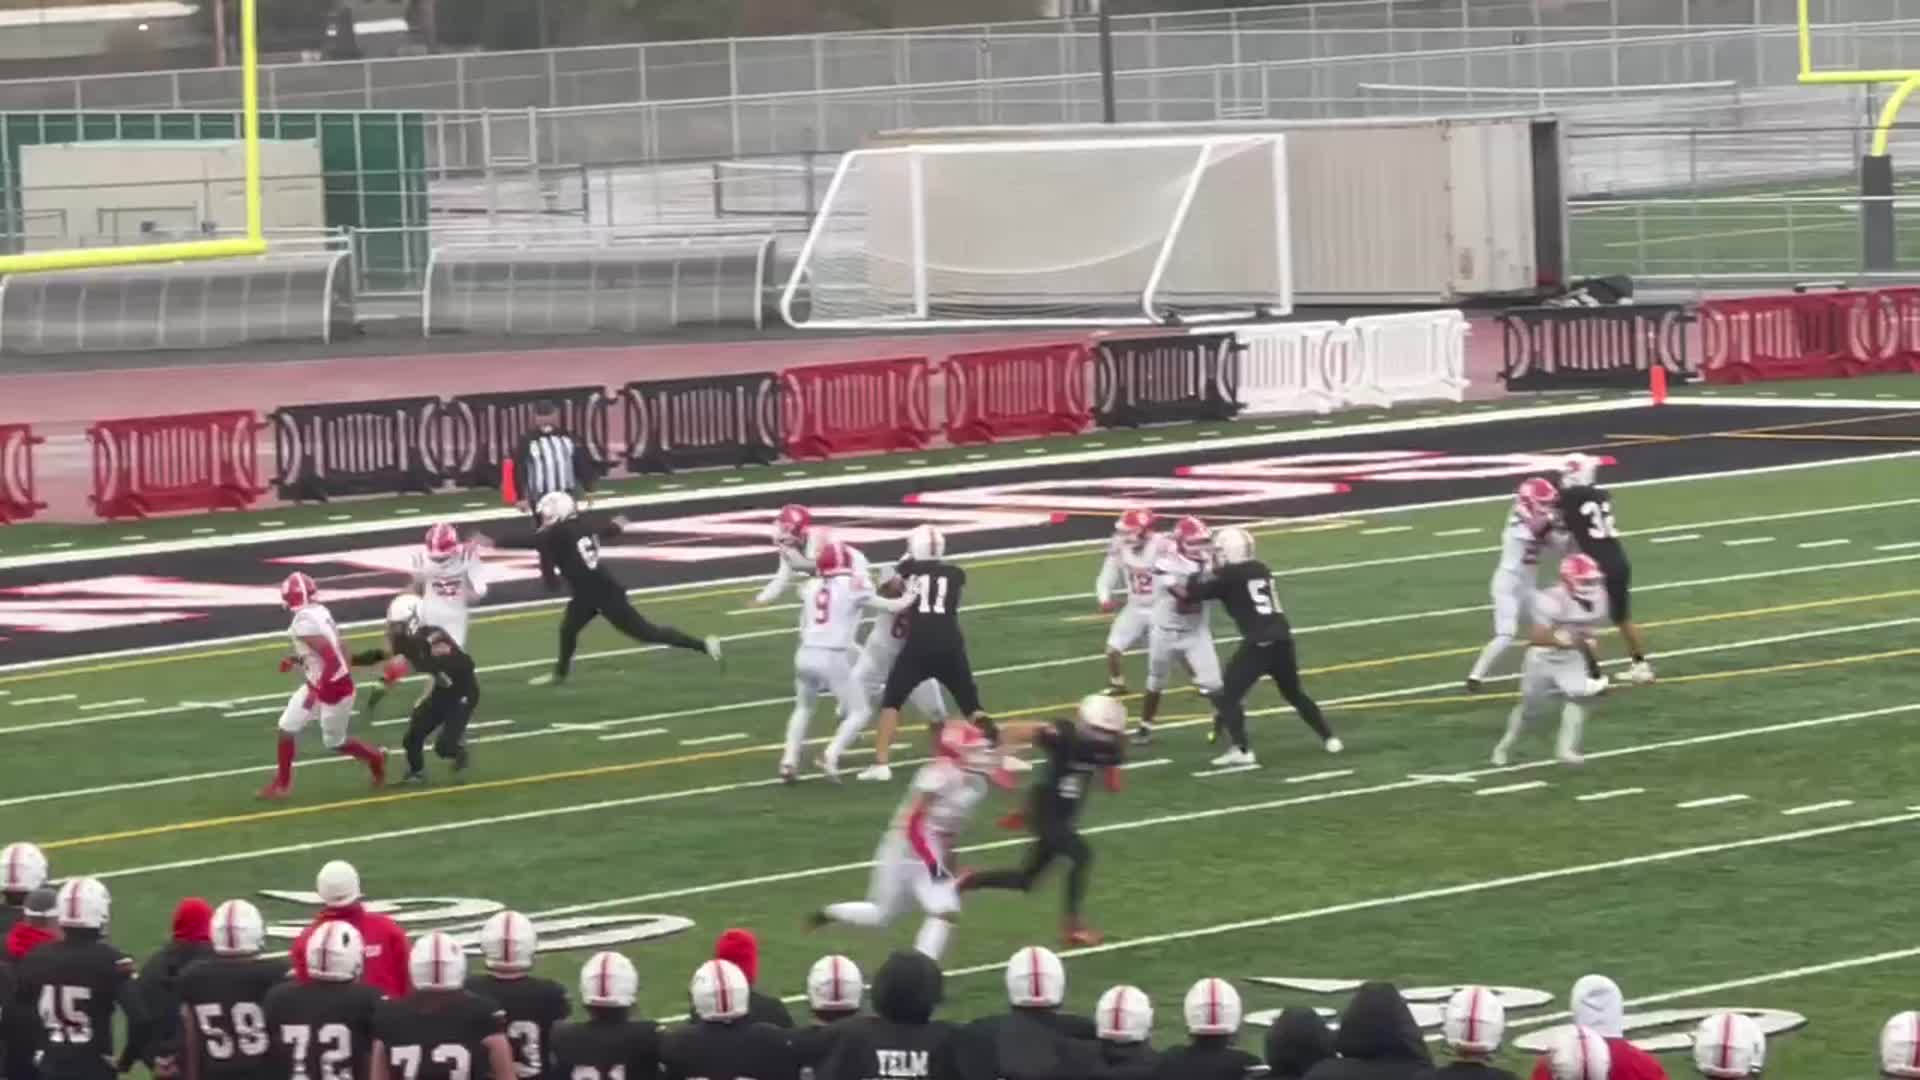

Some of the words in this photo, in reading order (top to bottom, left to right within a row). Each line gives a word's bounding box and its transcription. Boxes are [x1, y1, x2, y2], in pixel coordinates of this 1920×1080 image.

[0, 451, 1616, 643] NADOS
[815, 587, 831, 625] 9
[914, 574, 948, 614] 11
[37, 983, 94, 1043] 45
[194, 1001, 270, 1060] 58
[280, 1022, 354, 1080] 72
[508, 1020, 542, 1079] 3
[875, 1049, 929, 1077] YELM
